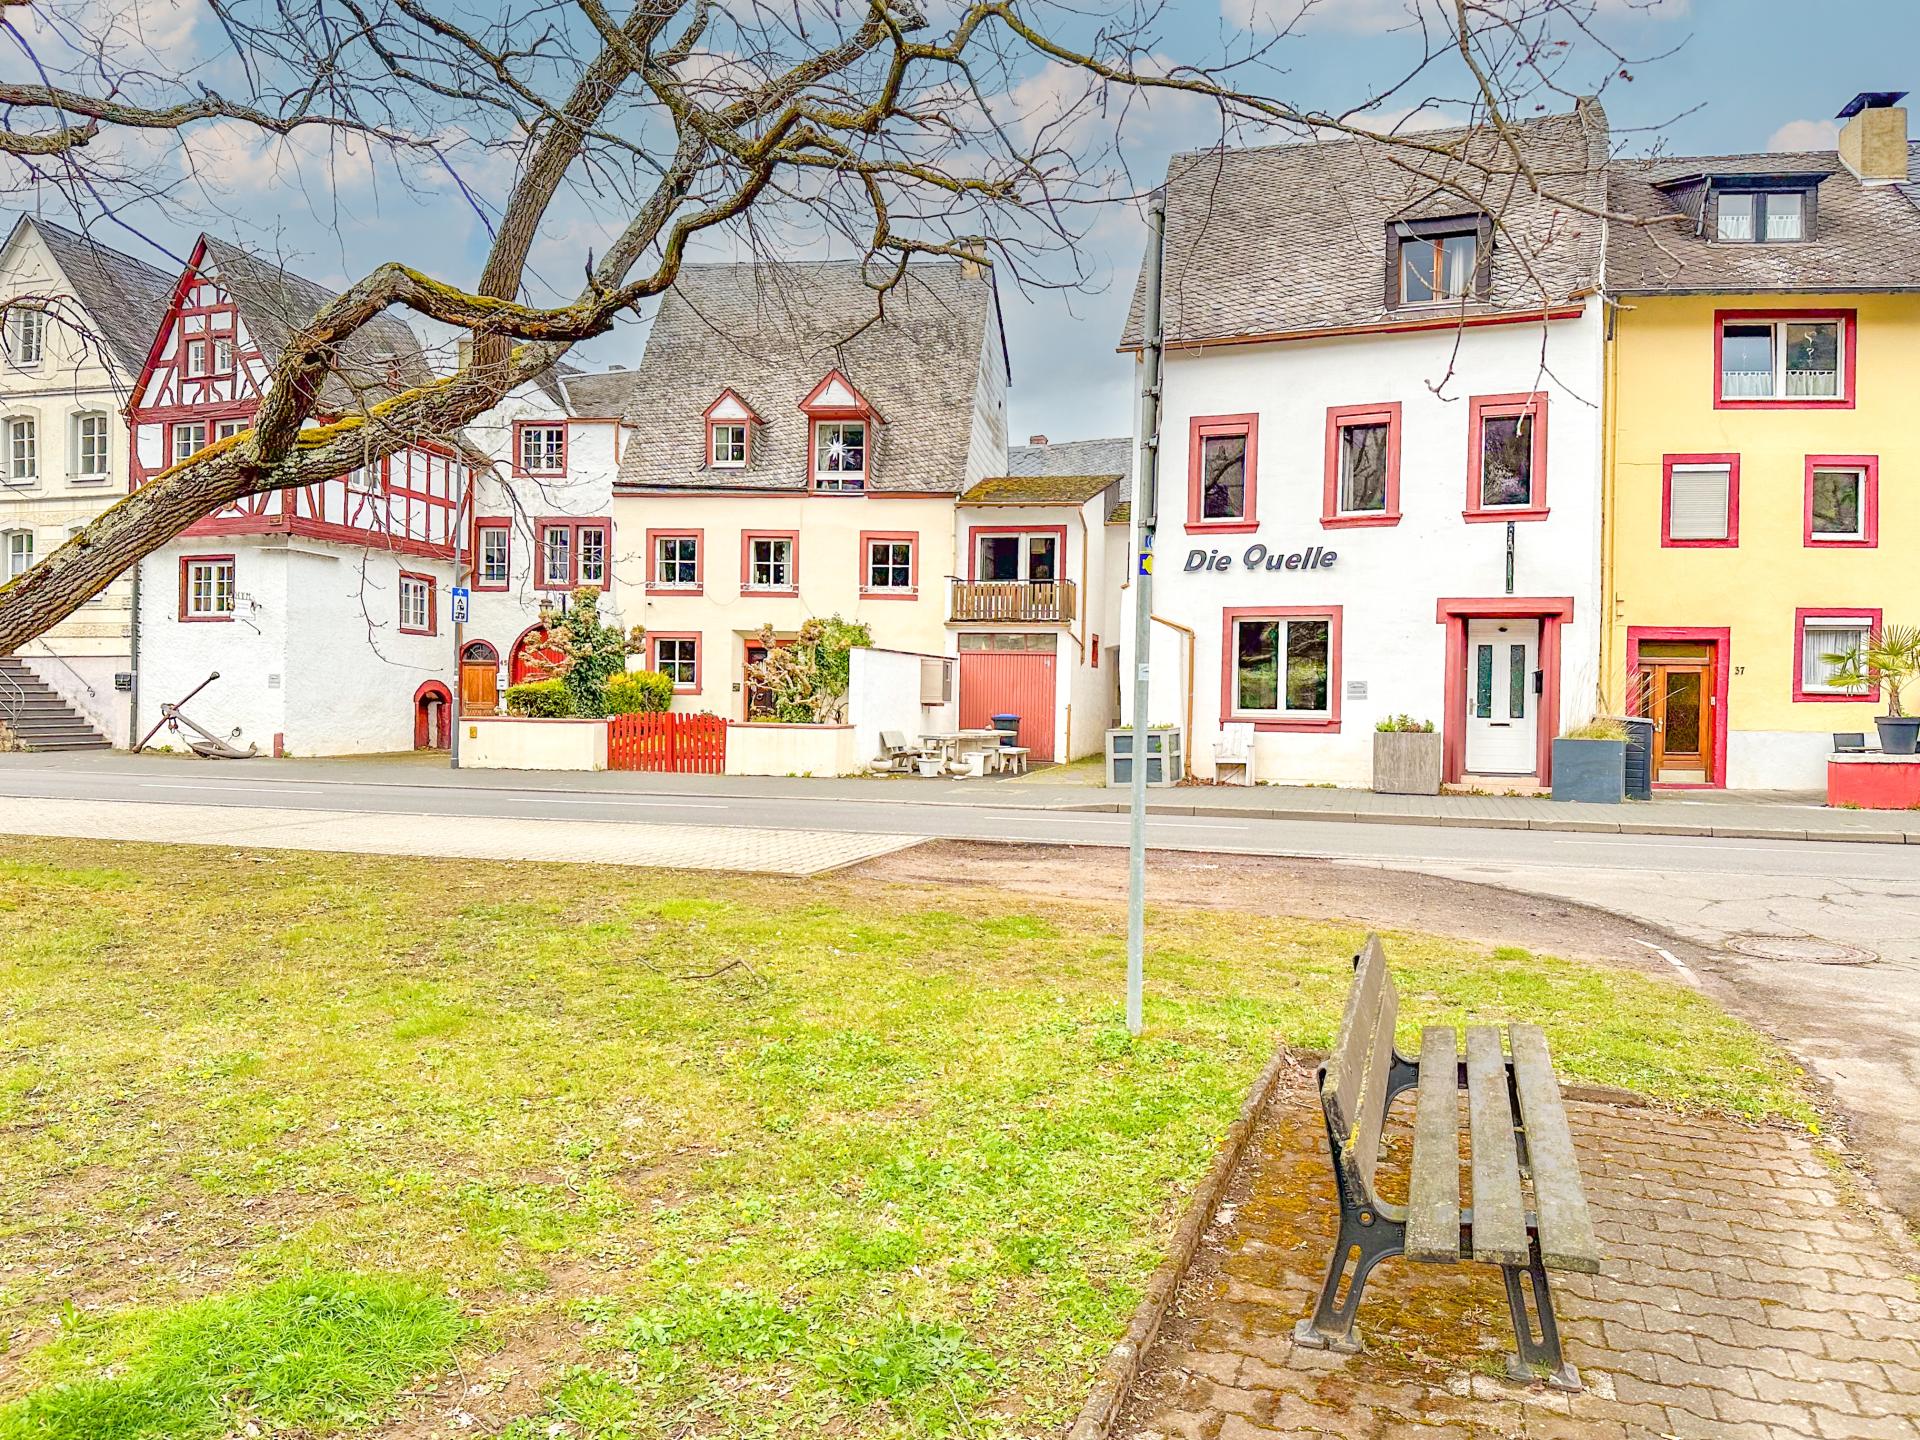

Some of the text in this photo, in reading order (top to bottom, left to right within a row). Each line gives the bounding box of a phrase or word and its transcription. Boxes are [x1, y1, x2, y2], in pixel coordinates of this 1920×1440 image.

[1184, 543, 1338, 571] Die Quelle
[1734, 666, 1745, 676] 37
